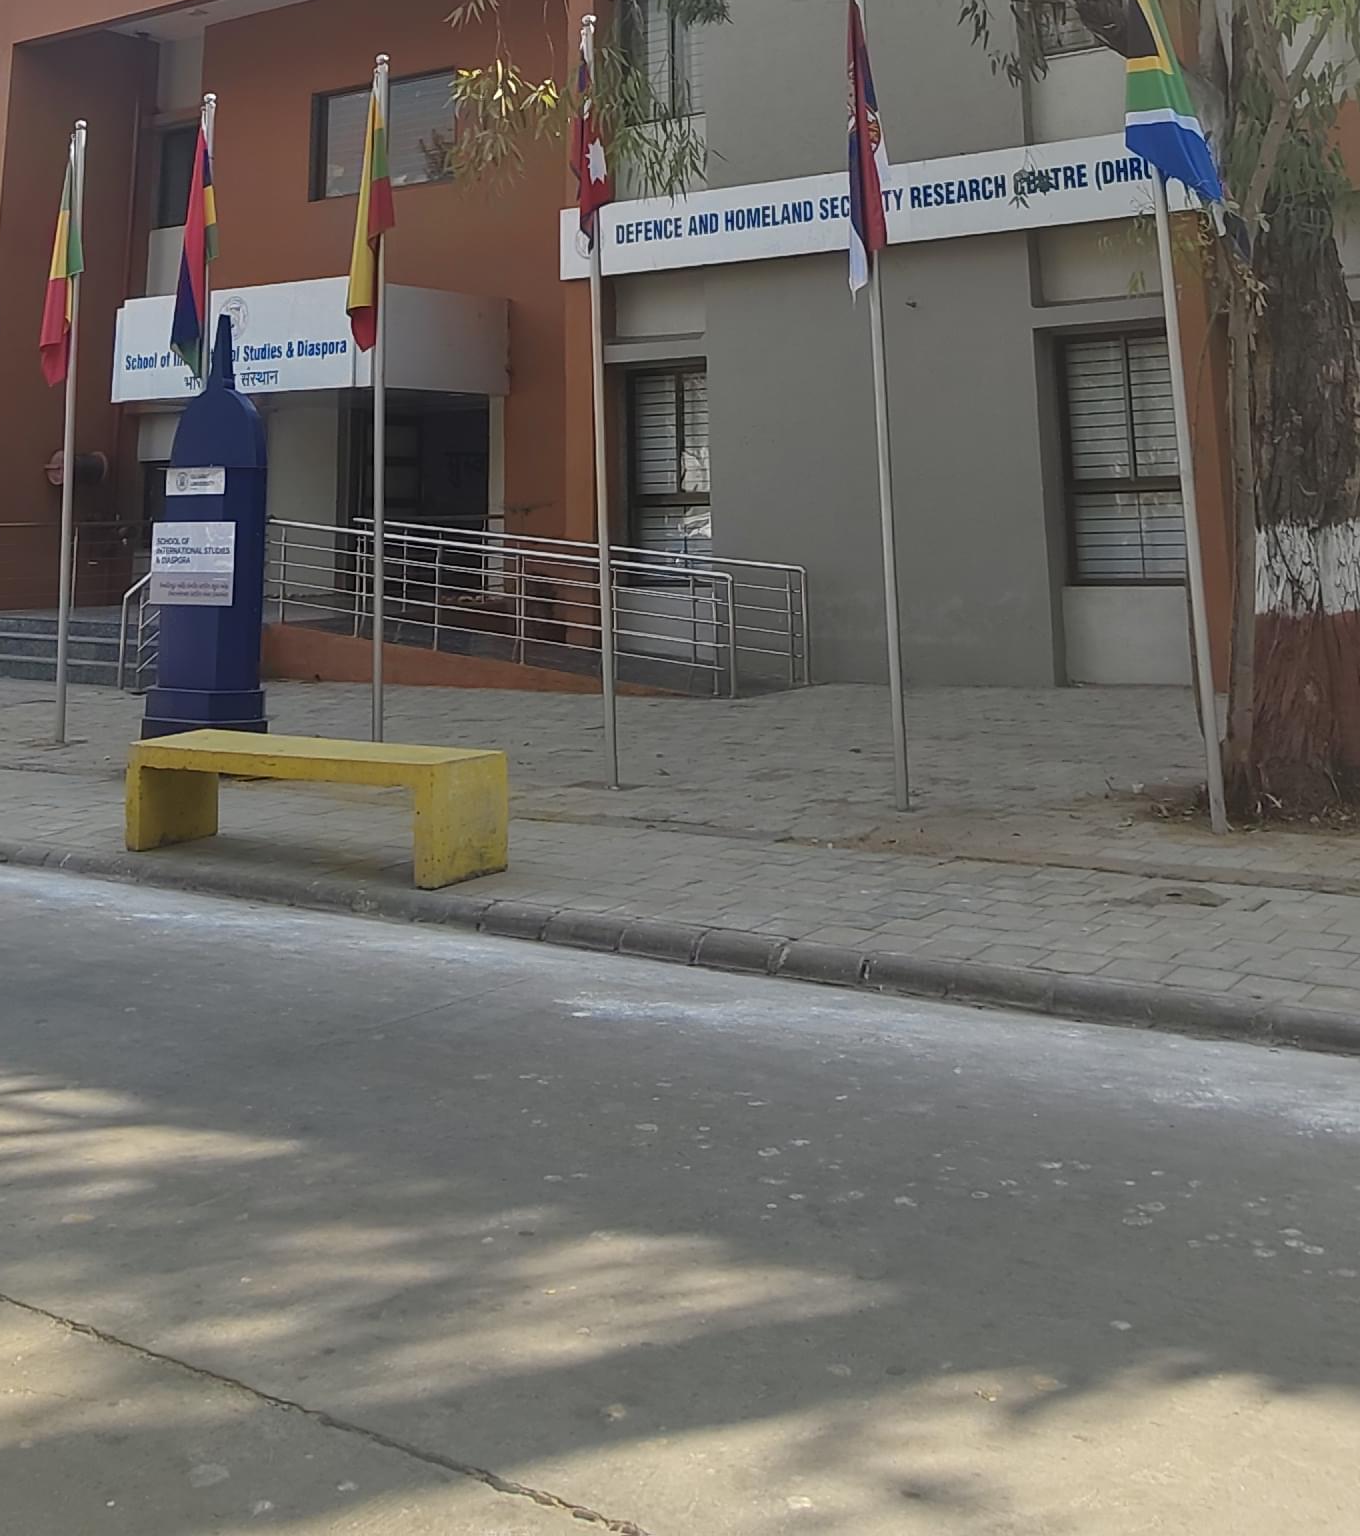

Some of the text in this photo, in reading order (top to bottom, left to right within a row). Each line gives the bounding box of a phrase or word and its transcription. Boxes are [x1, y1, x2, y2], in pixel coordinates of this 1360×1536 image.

[615, 217, 683, 245] DEFENCE
[687, 212, 720, 236] AND
[723, 200, 815, 233] HOMELAND
[819, 189, 903, 221] SECTY
[910, 175, 1007, 210] RESEARCH
[125, 351, 158, 371] School
[160, 351, 171, 369] of
[242, 343, 283, 363] Studies
[285, 341, 295, 359] &
[296, 339, 347, 361] Diaspora
[240, 366, 279, 387] संस्थान
